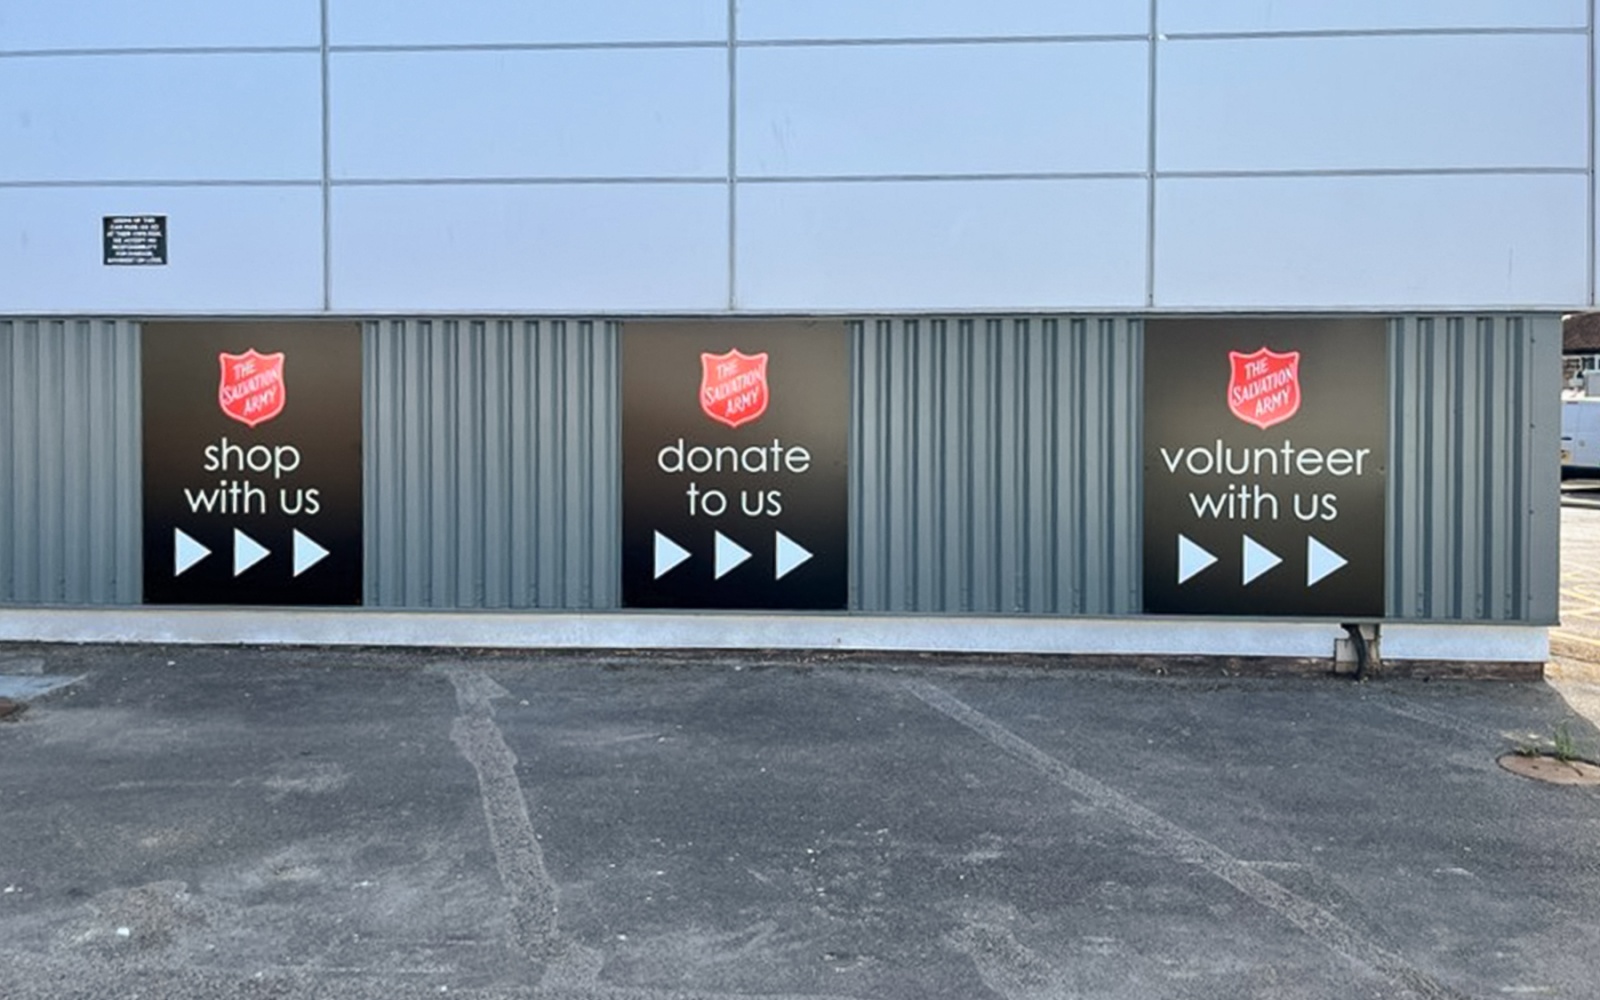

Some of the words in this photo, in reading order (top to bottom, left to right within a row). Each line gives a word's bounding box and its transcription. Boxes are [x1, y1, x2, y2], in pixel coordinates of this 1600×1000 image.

[222, 367, 280, 405] SALVATION
[233, 359, 256, 379] THE
[705, 365, 763, 406] SALVATION
[716, 360, 739, 380] THE
[1233, 365, 1294, 406] SALVATION
[1244, 357, 1269, 380] THE
[243, 386, 277, 415] ARMY
[725, 386, 760, 417] ARMY
[1254, 386, 1291, 417] ARMY
[203, 436, 300, 479] shop
[657, 438, 810, 473] donate
[1160, 439, 1370, 475] volunteer
[184, 479, 266, 514] with
[280, 488, 320, 515] us
[686, 482, 727, 516] to
[741, 490, 782, 516] us
[1189, 483, 1278, 520] with
[1293, 493, 1338, 521] us
